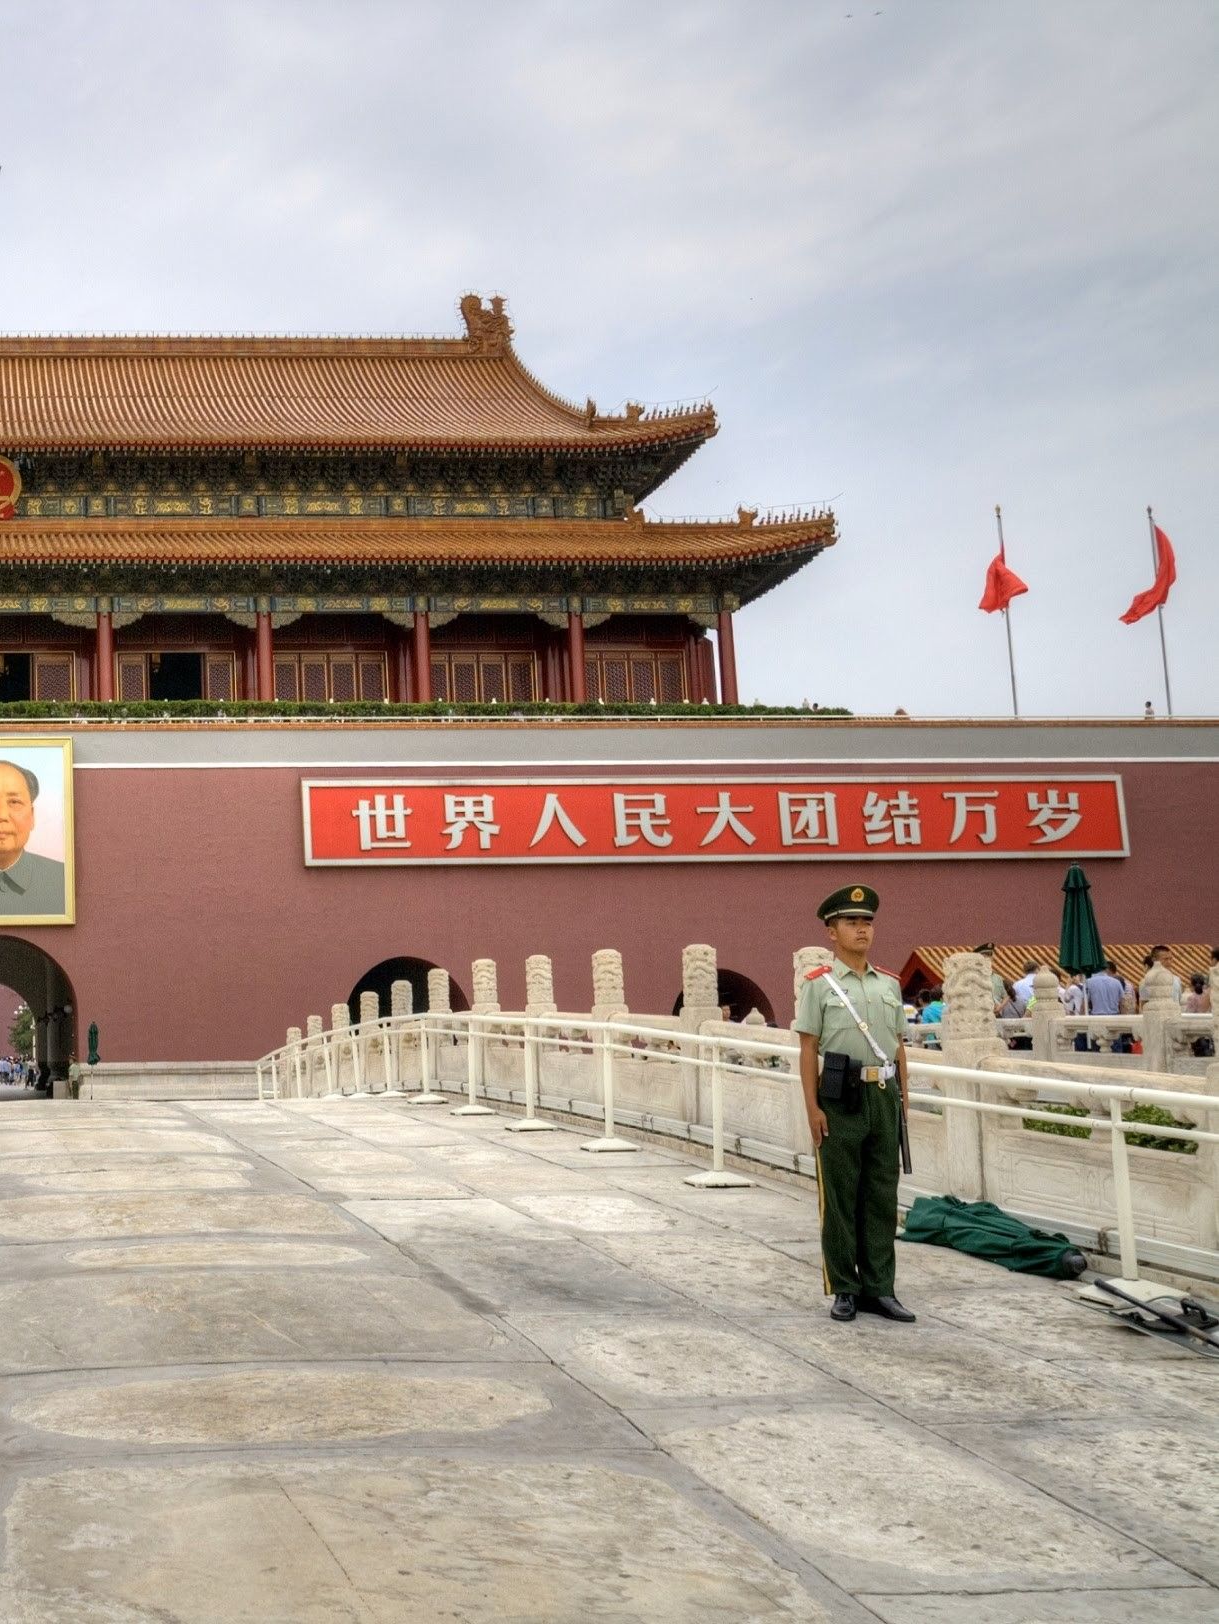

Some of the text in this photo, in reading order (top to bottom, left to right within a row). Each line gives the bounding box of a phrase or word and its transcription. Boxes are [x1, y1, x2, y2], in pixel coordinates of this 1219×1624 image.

[351, 789, 1083, 851] 世界人民大团结万岁
